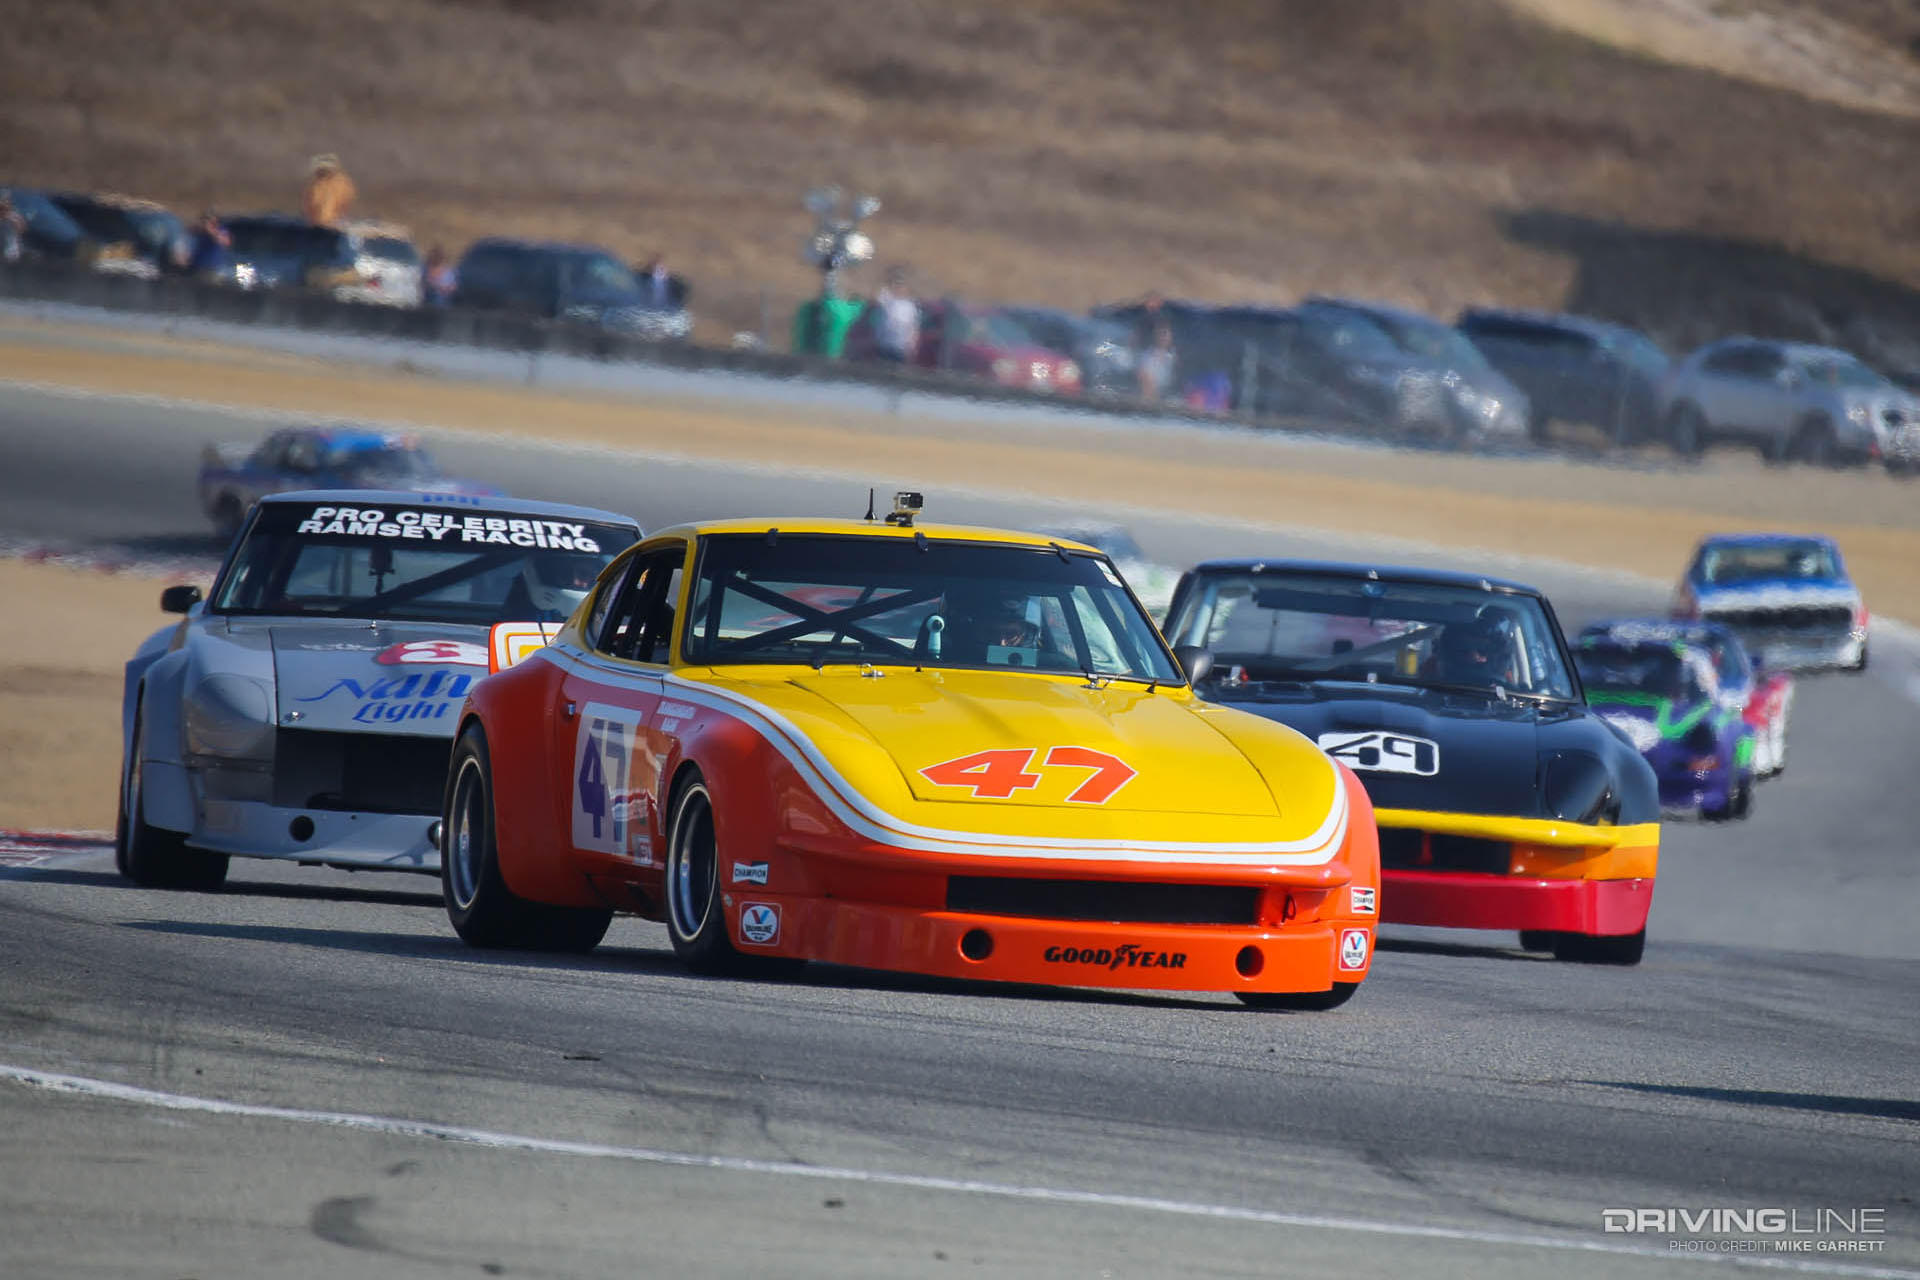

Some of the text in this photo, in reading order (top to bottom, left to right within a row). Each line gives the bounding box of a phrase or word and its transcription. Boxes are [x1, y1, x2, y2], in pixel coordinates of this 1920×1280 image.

[297, 520, 600, 553] RAMSEY RACING
[311, 507, 585, 537] PRO CELEBRITY
[352, 701, 449, 724] Light
[1324, 734, 1435, 773] 49
[579, 718, 627, 843] 47
[917, 745, 1139, 804] 47
[1044, 945, 1187, 970] GOODYEAR
